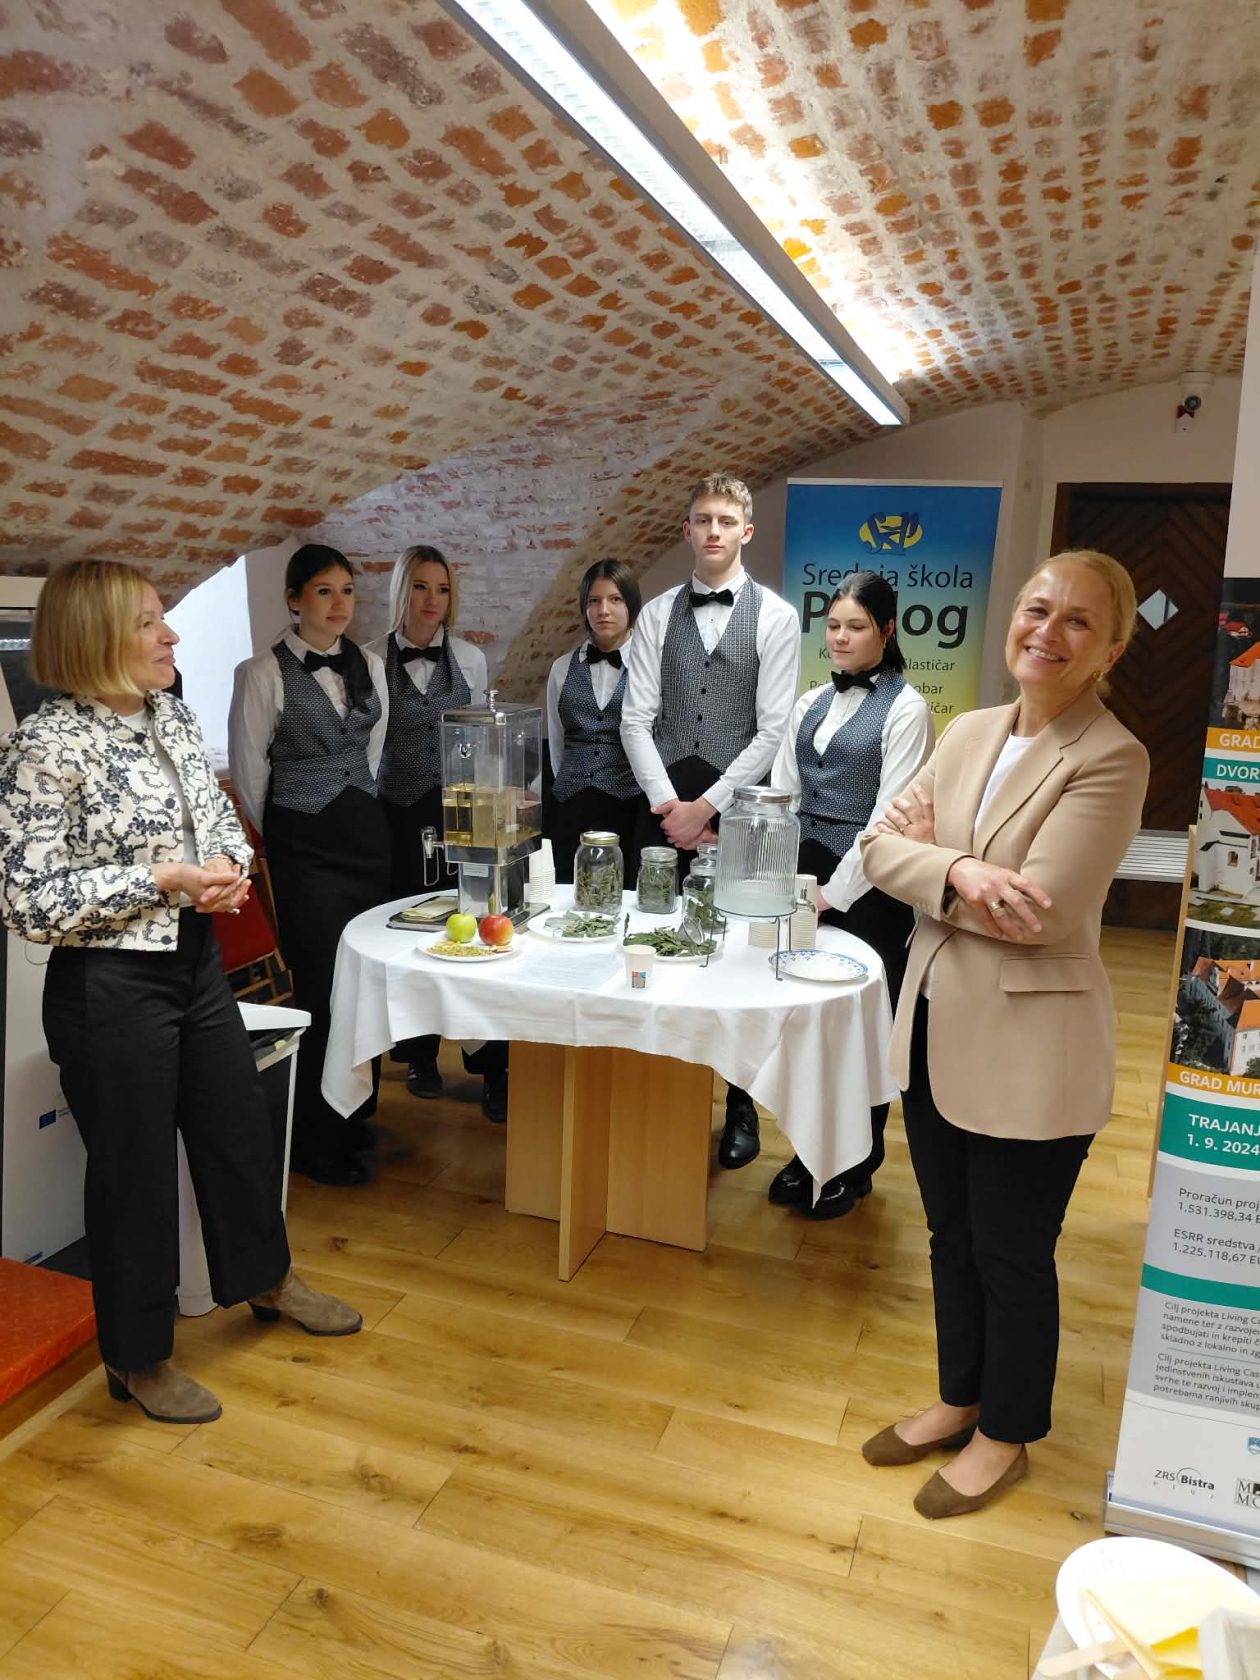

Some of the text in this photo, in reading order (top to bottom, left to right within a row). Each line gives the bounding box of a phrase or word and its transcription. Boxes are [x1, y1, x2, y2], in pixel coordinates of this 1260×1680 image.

[803, 563, 973, 588] Srea škola
[802, 590, 968, 650] Pog
[904, 657, 955, 671] lastičar
[1216, 764, 1260, 780] DVOR
[1179, 1070, 1260, 1095] GRAD MUR
[1188, 1113, 1260, 1136] TRAJANJ
[1188, 1133, 1260, 1155] 1. 9. 2024
[1179, 1187, 1259, 1212] Proračun proj
[1178, 1202, 1252, 1222] 1.531.398,34
[1174, 1228, 1204, 1242] ESRR
[1207, 1238, 1255, 1250] sredstva
[1174, 1242, 1246, 1263] 1.225.118,67
[1163, 1313, 1200, 1326] namene
[1202, 1320, 1214, 1328] ter
[1165, 1302, 1179, 1314] Cilj
[1181, 1306, 1219, 1319] projekta
[1222, 1312, 1249, 1325] Living
[1161, 1333, 1195, 1346] skladno
[1205, 1341, 1237, 1353] lokalno
[1162, 1323, 1209, 1338] spodbujati
[1212, 1332, 1220, 1340] in
[1223, 1333, 1252, 1346] krepiti
[1156, 1364, 1254, 1387] jedinstvenih iskustava
[1157, 1353, 1172, 1364] Cilj
[1174, 1357, 1212, 1370] projekta
[1215, 1364, 1241, 1376] Living
[1153, 1384, 1203, 1400] potrebama
[1193, 1381, 1220, 1393] razvoj
[1154, 1469, 1215, 1490] ZRS Bistra
